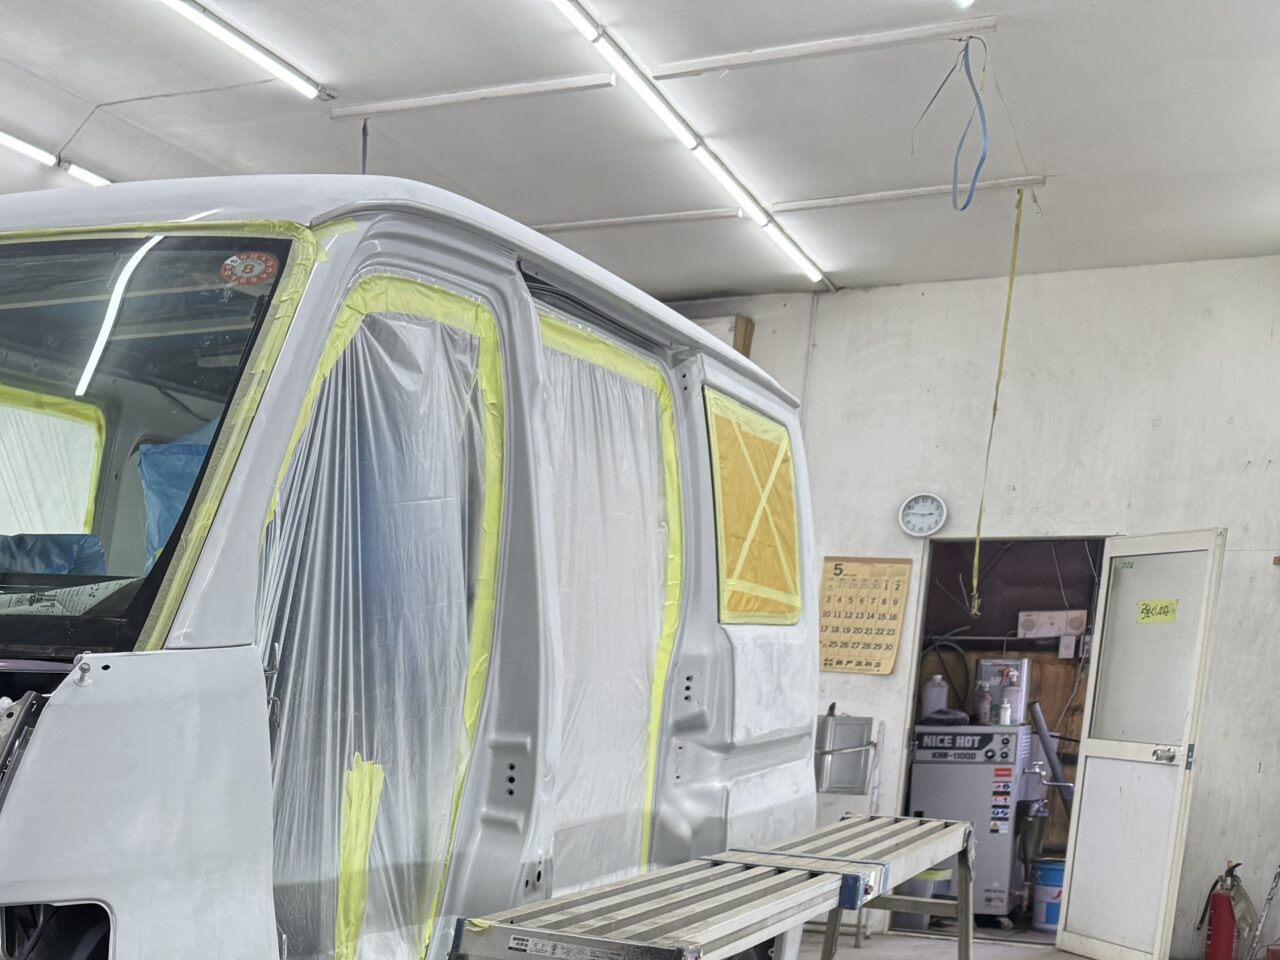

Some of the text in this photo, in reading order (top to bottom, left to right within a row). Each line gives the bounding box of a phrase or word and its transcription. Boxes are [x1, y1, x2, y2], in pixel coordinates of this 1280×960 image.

[833, 563, 843, 576] 5
[822, 610, 831, 618] 10
[889, 613, 897, 621] 16
[923, 735, 981, 748] NICE HOT
